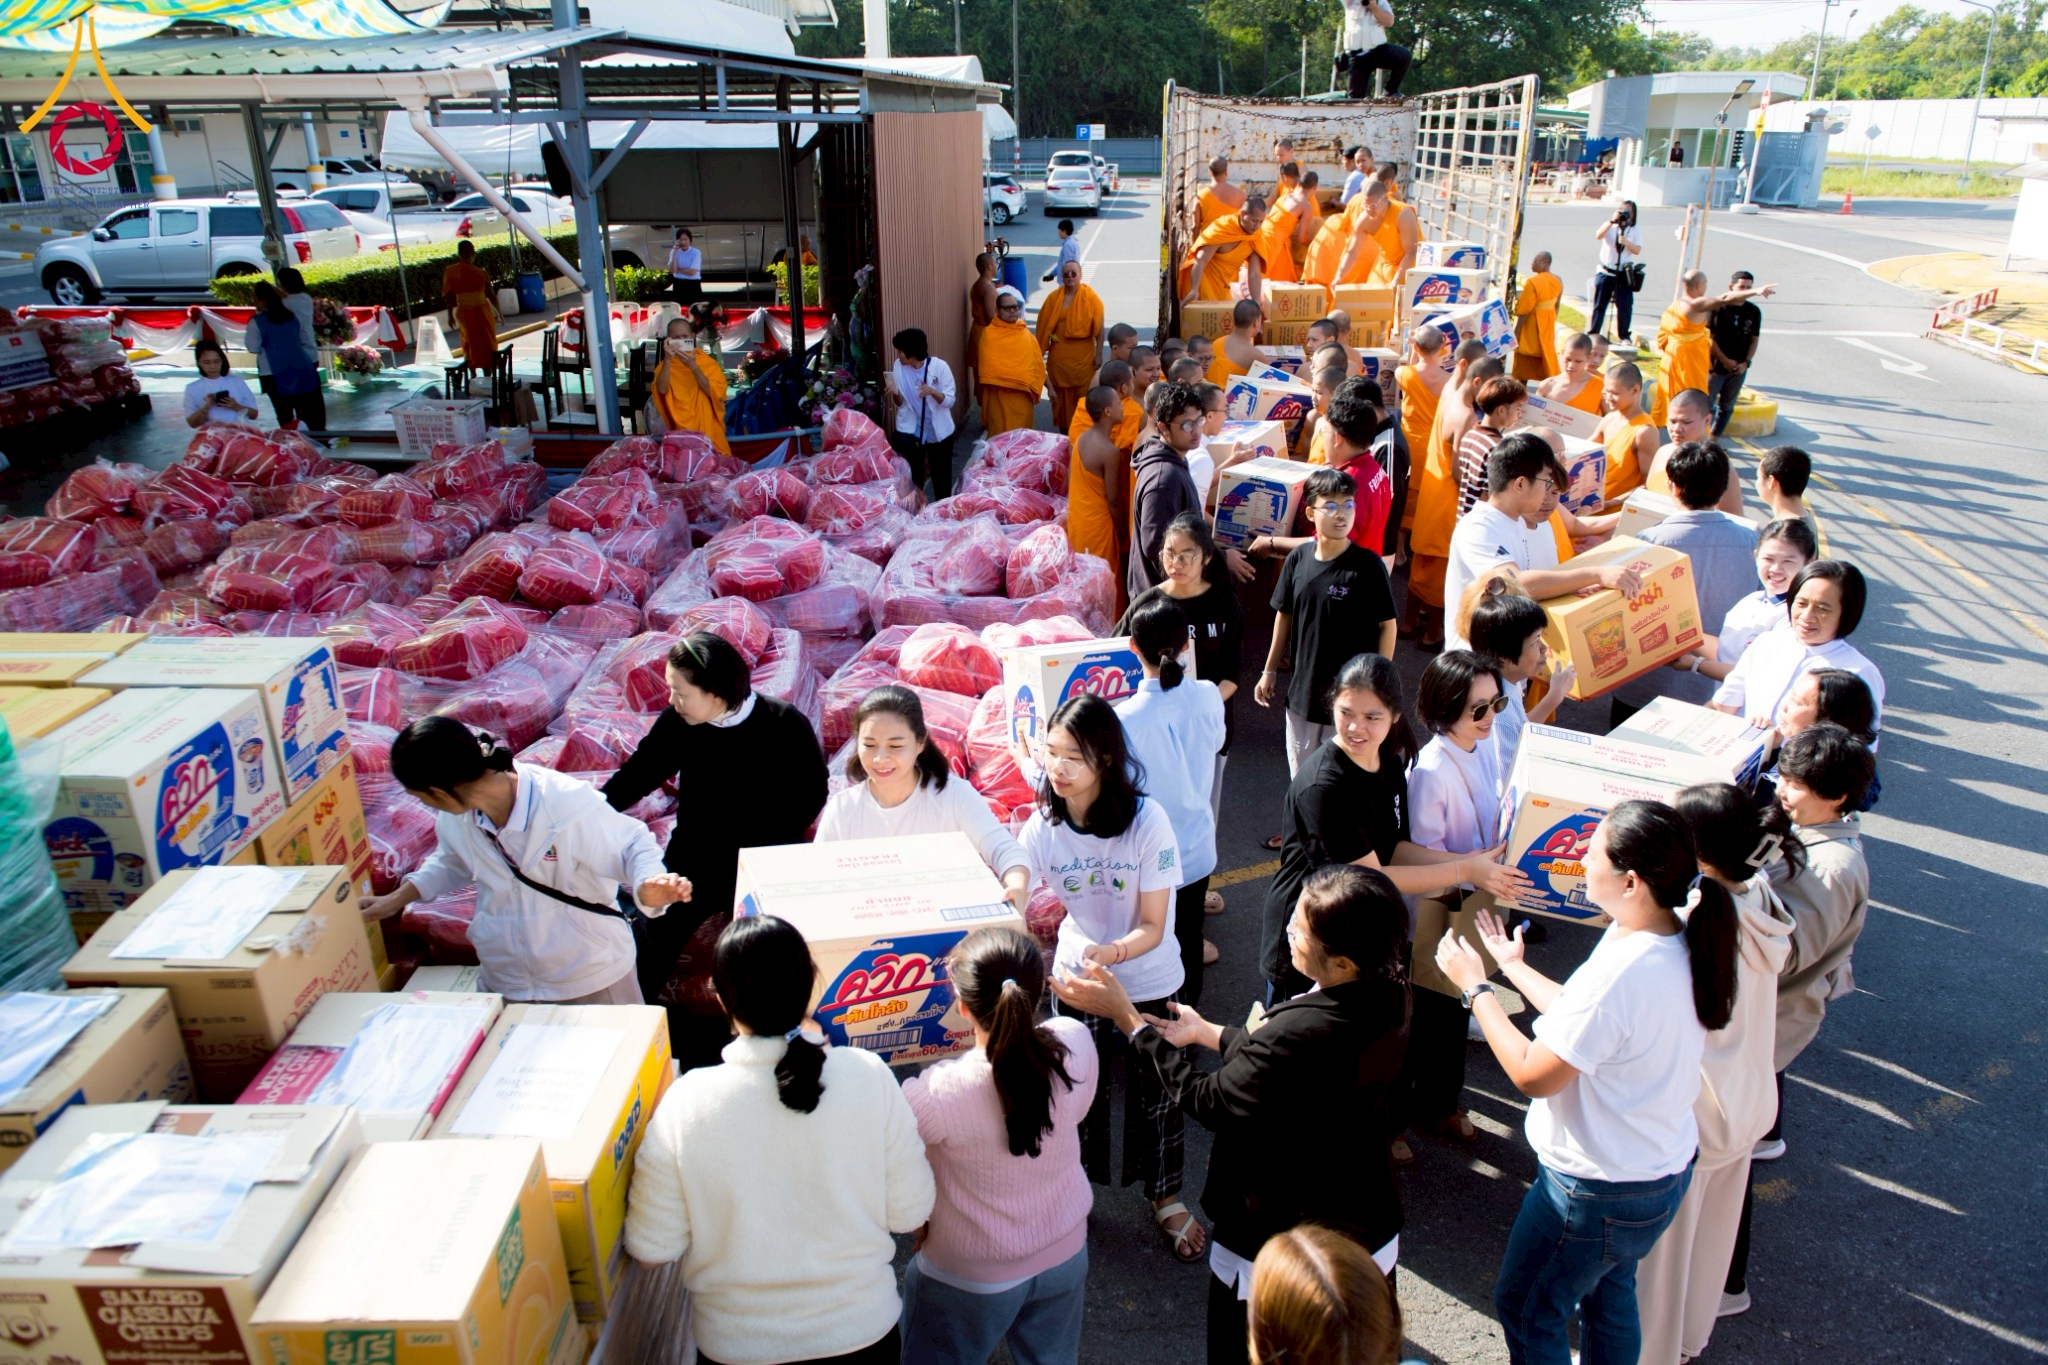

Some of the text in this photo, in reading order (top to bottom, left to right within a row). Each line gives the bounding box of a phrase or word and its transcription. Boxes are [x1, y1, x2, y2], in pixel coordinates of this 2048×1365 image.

[1080, 127, 1088, 137] P
[160, 757, 210, 828] ควิก
[1544, 822, 1599, 854] ควิ
[1050, 857, 1138, 875] meditation
[835, 952, 927, 1003] ควิก
[99, 1289, 205, 1307] SALTED
[98, 1306, 223, 1326] CASSAVA
[118, 1324, 215, 1343] CHIPS
